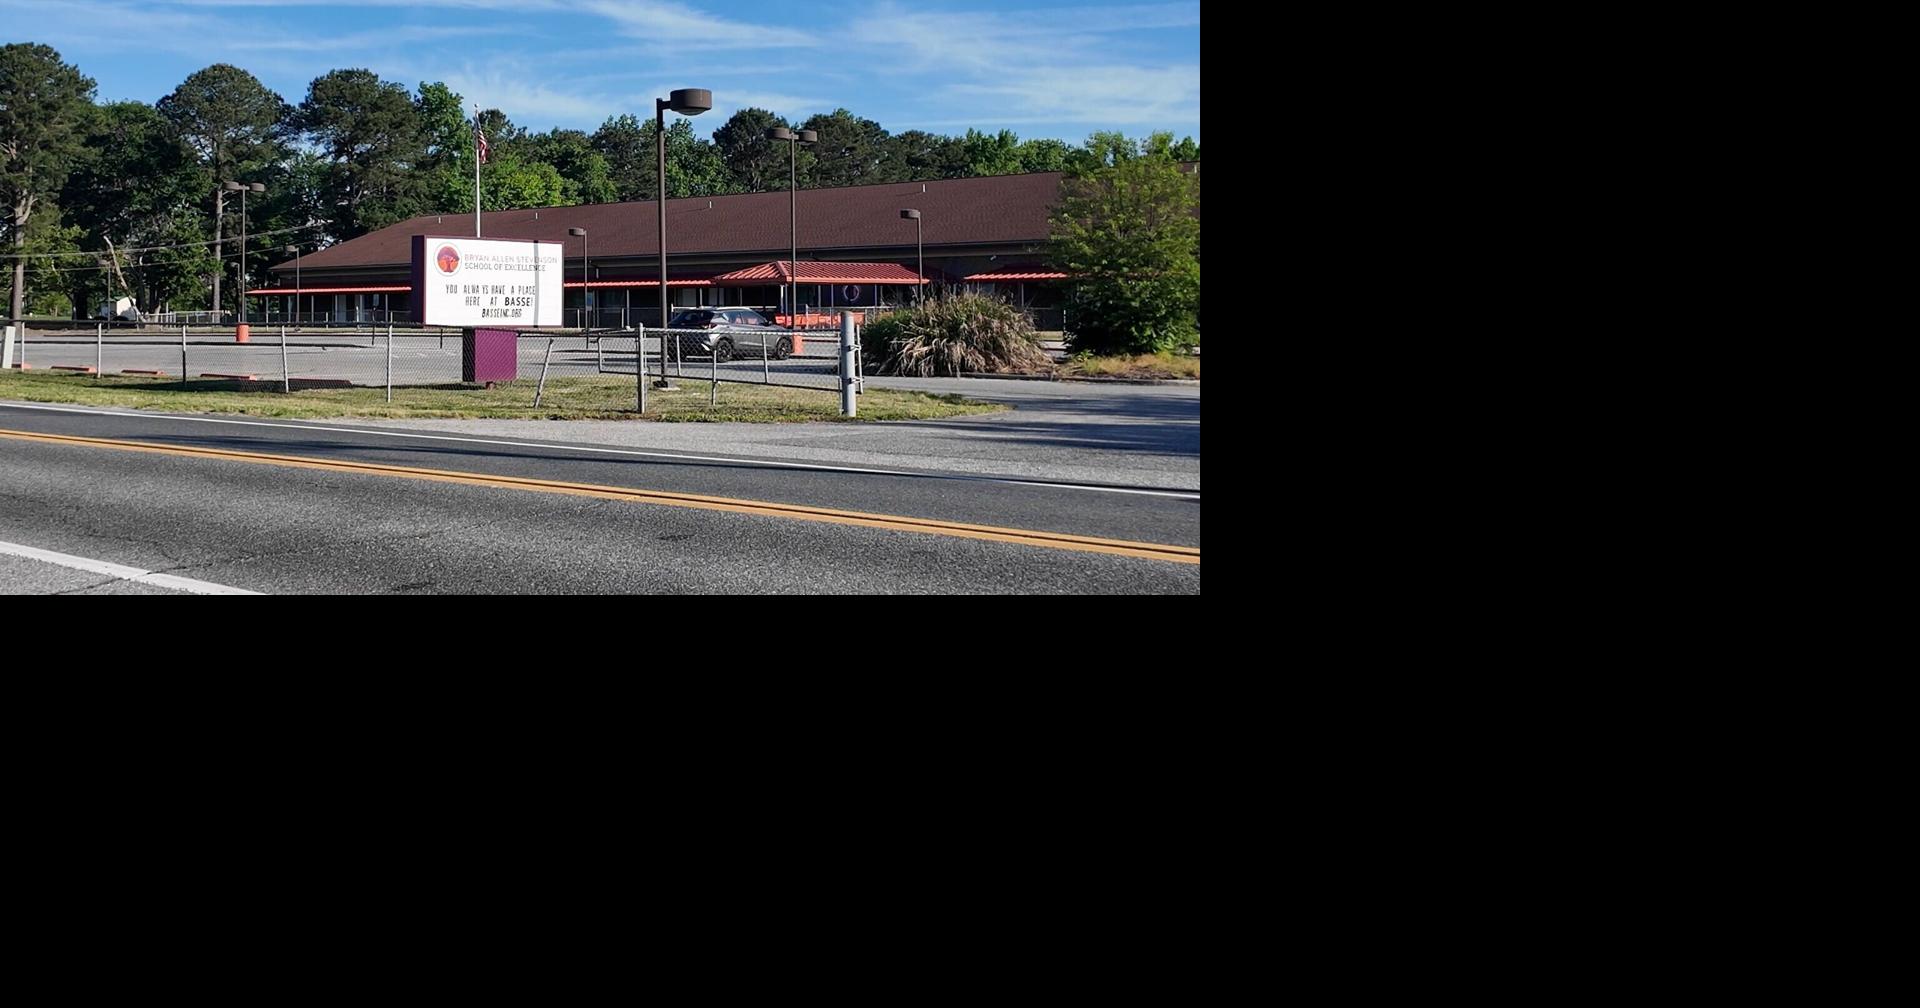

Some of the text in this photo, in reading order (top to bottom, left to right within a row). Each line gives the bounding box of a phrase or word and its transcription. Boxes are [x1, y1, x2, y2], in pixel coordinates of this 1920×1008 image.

[464, 254, 489, 262] BRYAN
[464, 262, 492, 270] SCHOOL
[504, 264, 546, 272] EXCELLENCE
[446, 284, 458, 294] YOU
[491, 285, 505, 295] HAVE
[511, 286, 515, 295] A
[518, 286, 536, 295] PLACE
[465, 296, 480, 306] HERE
[490, 297, 498, 306] AT
